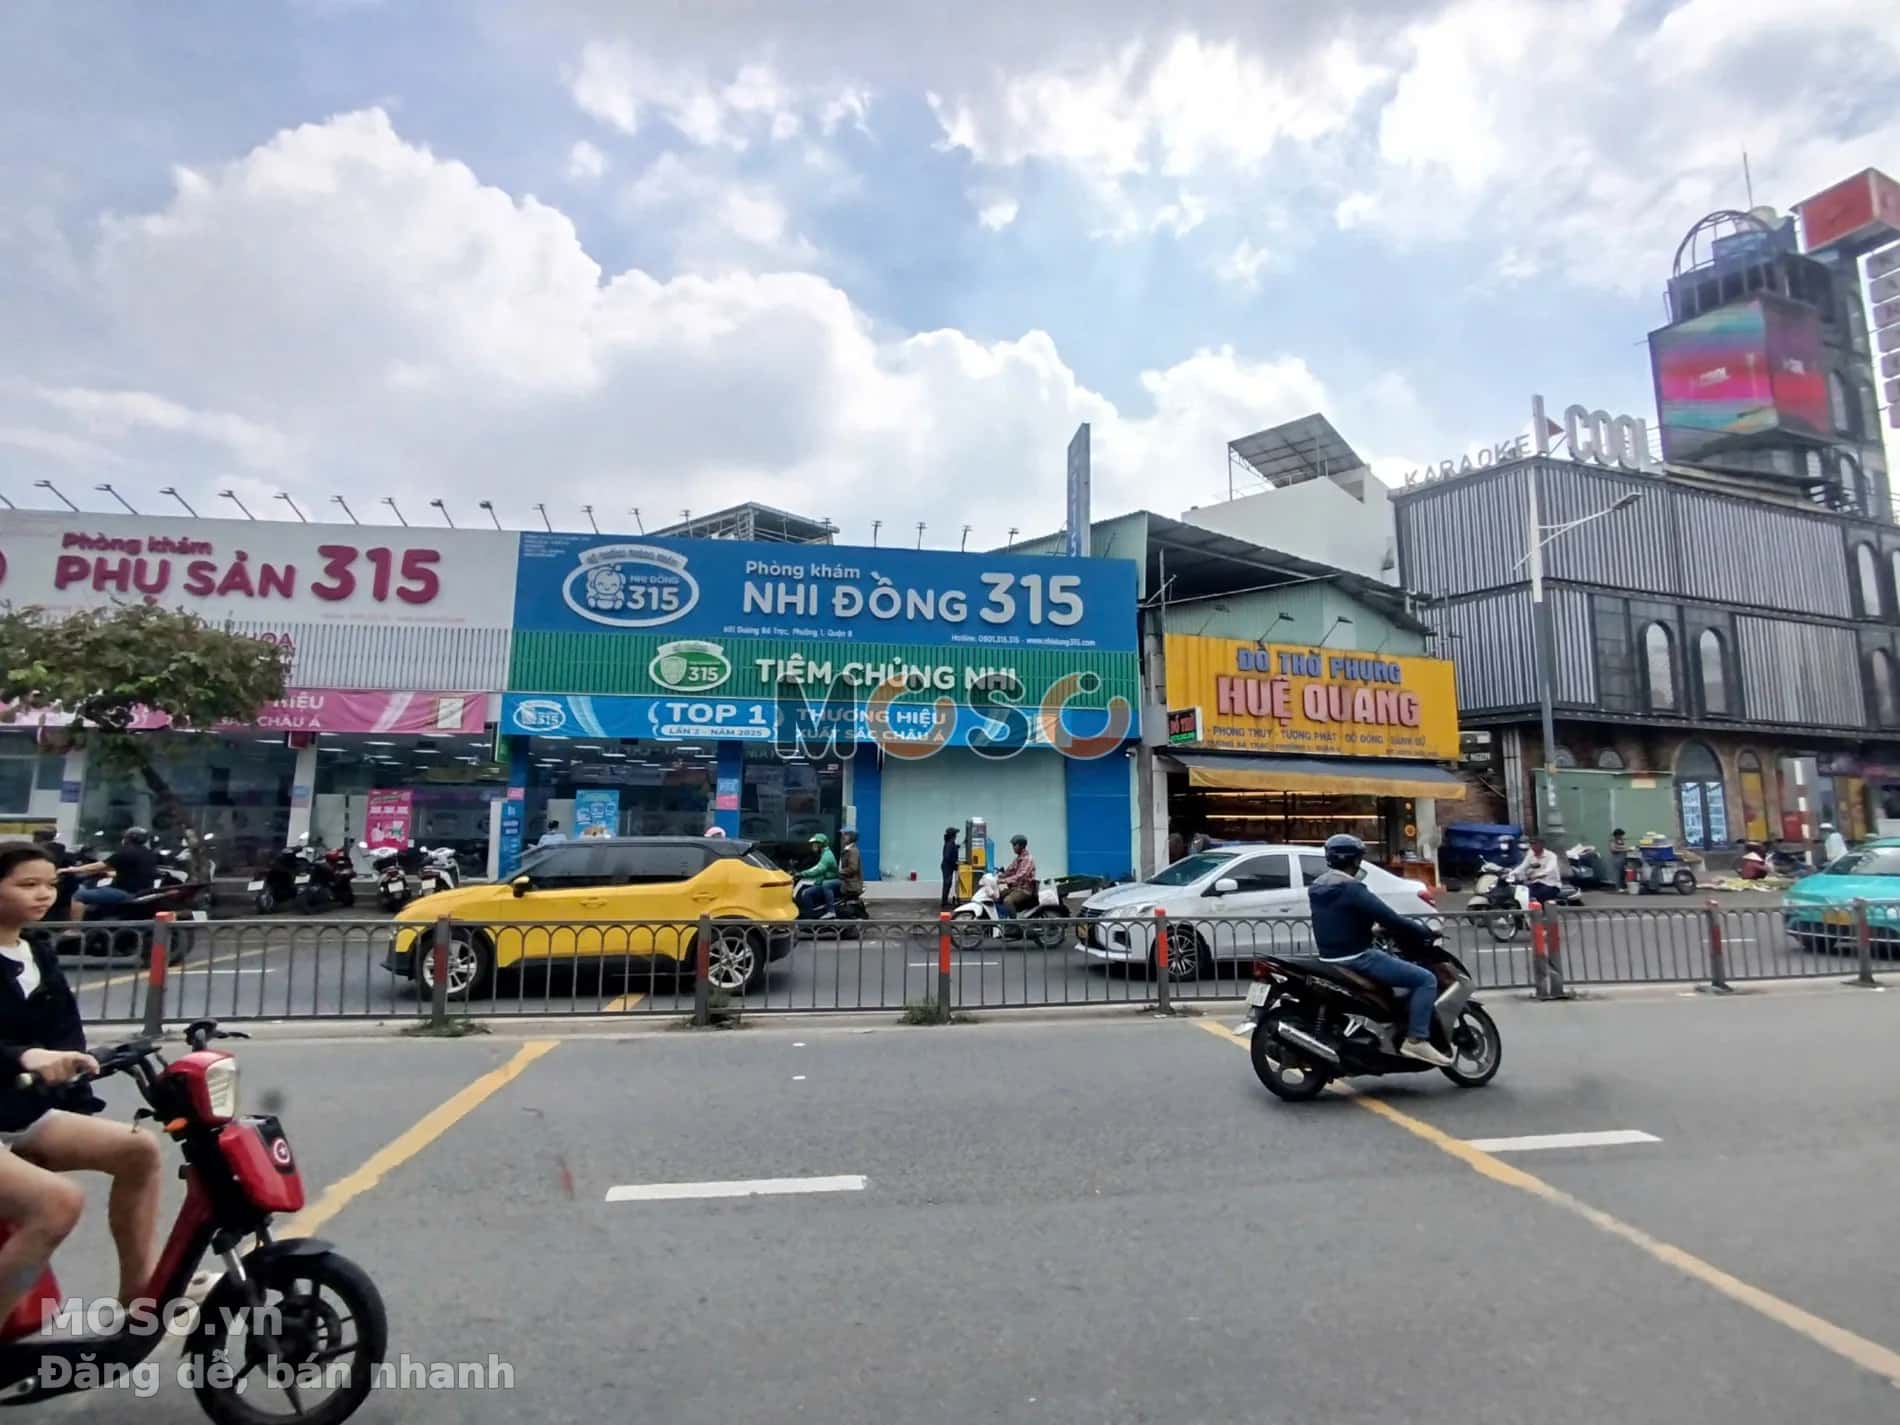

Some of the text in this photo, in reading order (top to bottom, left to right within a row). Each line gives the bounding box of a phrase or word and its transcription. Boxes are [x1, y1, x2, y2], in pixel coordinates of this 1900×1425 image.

[1404, 433, 1531, 488] KARAOKE
[62, 531, 212, 557] Phòng khám
[54, 545, 441, 607] PHỤ SẢN 315
[746, 561, 860, 578] Phòng khám
[627, 585, 680, 612] 315
[743, 571, 1085, 626] NHI ĐỒNG 315
[687, 666, 719, 681] 315
[756, 653, 832, 686] TIÊM
[964, 667, 1017, 691] NHI
[666, 702, 767, 725] TOP 1
[1216, 674, 1420, 728] HUỆ QUANG
